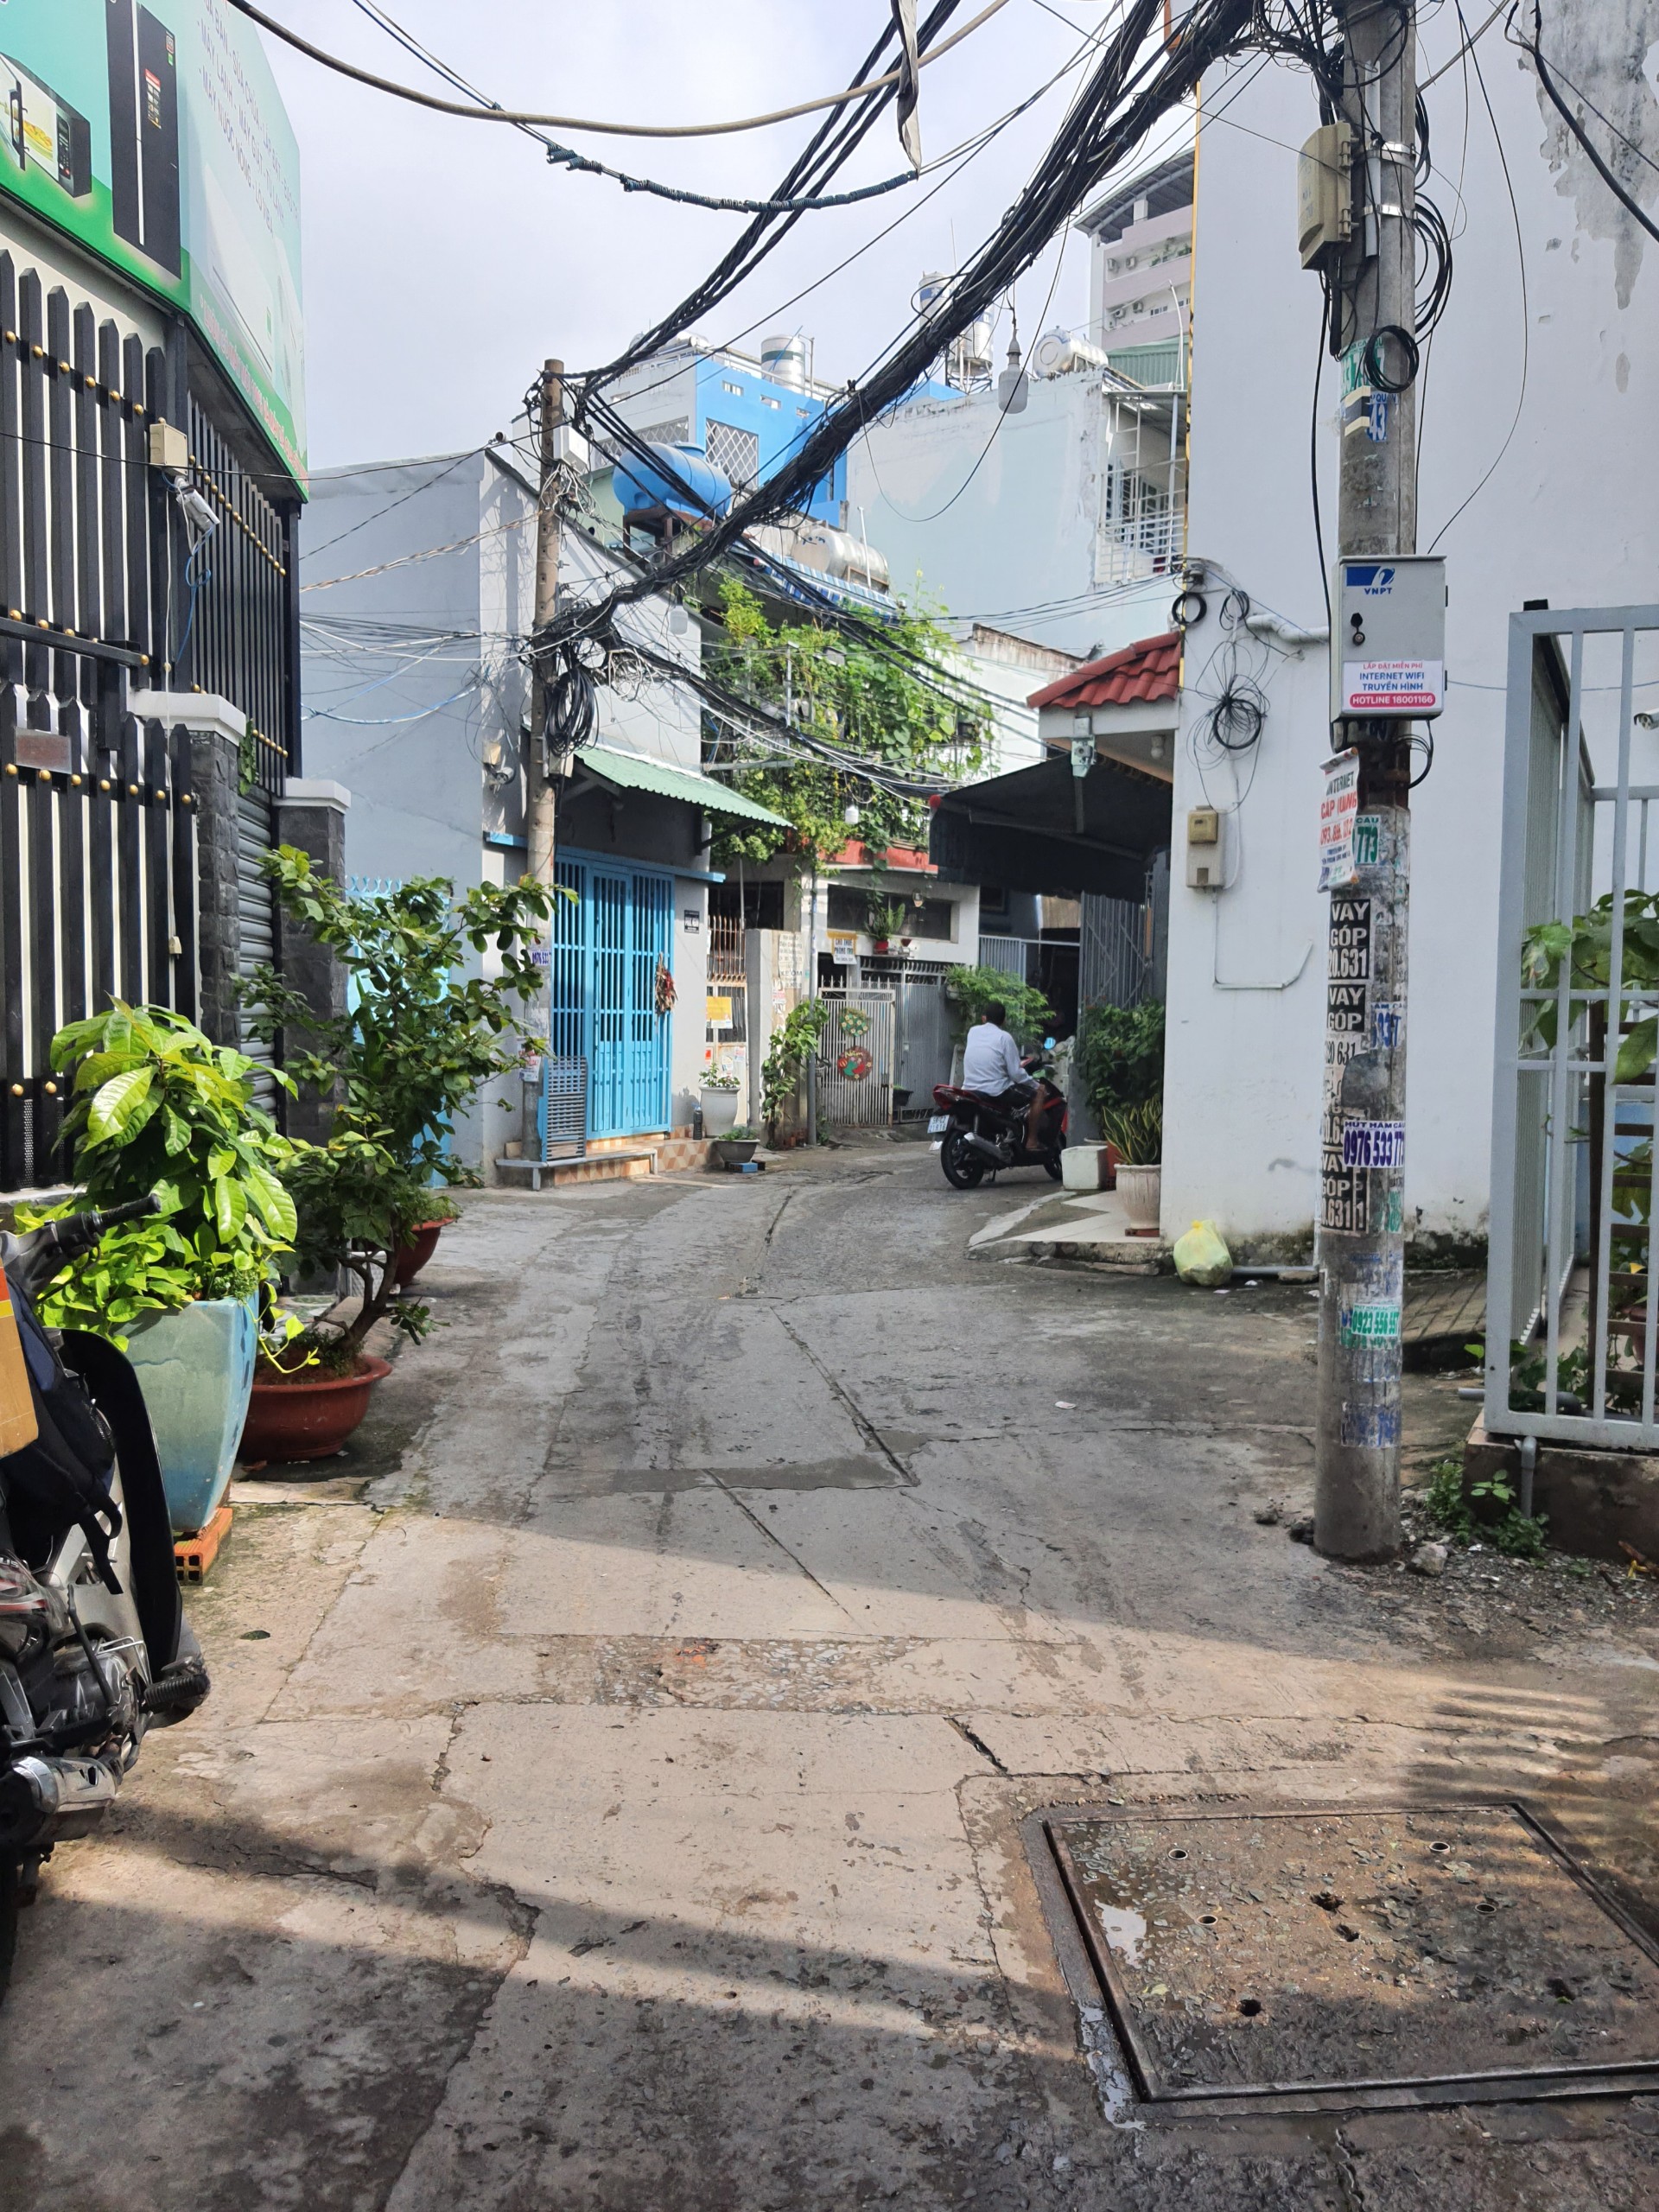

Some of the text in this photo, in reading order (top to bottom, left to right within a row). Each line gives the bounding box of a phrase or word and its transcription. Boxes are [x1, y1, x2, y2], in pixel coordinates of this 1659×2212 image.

[200, 17, 215, 67] MÁY
[202, 65, 216, 112] MÁY
[1360, 672, 1403, 681] INTERNET
[1363, 681, 1424, 691] TRUYỀN HÌNH
[1353, 695, 1433, 705] HOTLINE 18001166
[1332, 902, 1370, 921] VAY
[1331, 925, 1367, 946] GÓP
[1329, 988, 1364, 1006] VAY
[1328, 1008, 1362, 1031] GÓP
